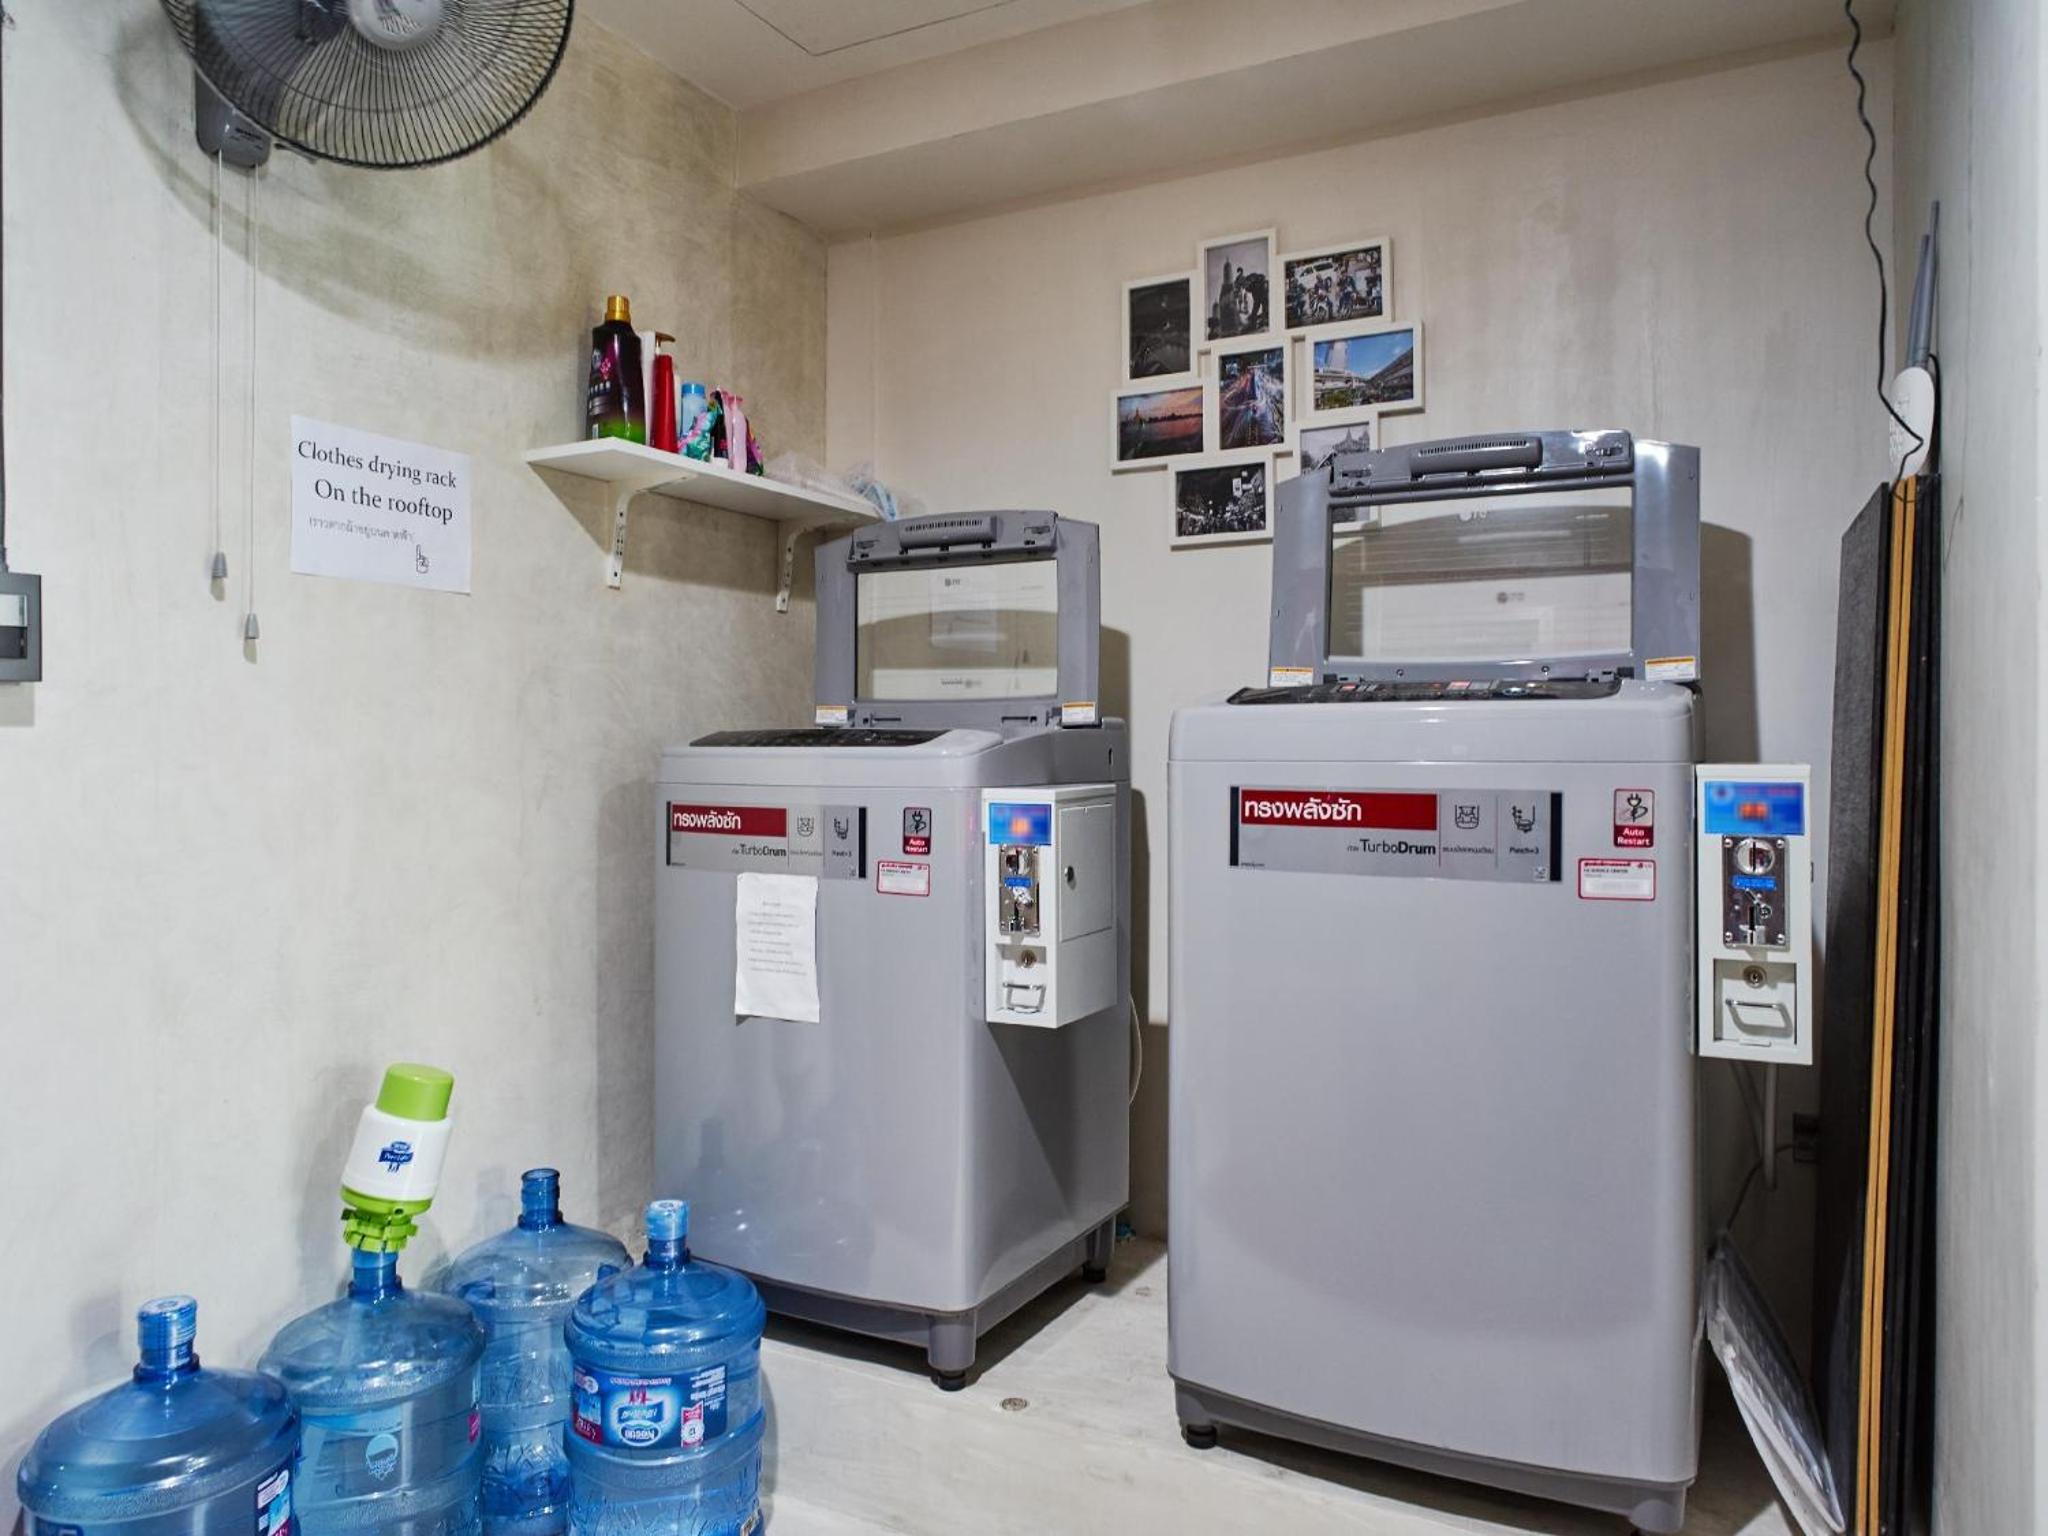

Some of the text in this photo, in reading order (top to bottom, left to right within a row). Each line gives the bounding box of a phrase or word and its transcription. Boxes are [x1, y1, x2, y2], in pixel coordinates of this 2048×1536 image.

[298, 440, 457, 488] Clothes drying rack
[314, 478, 453, 525] On the rooftop
[1244, 798, 1362, 821] ทรงพลังซัก
[673, 809, 741, 830] ทรงพลังซัก
[1623, 827, 1645, 836] Auto
[740, 843, 787, 857] TurboDrum
[1360, 838, 1436, 855] TurboDrum
[1617, 837, 1650, 846] Restart
